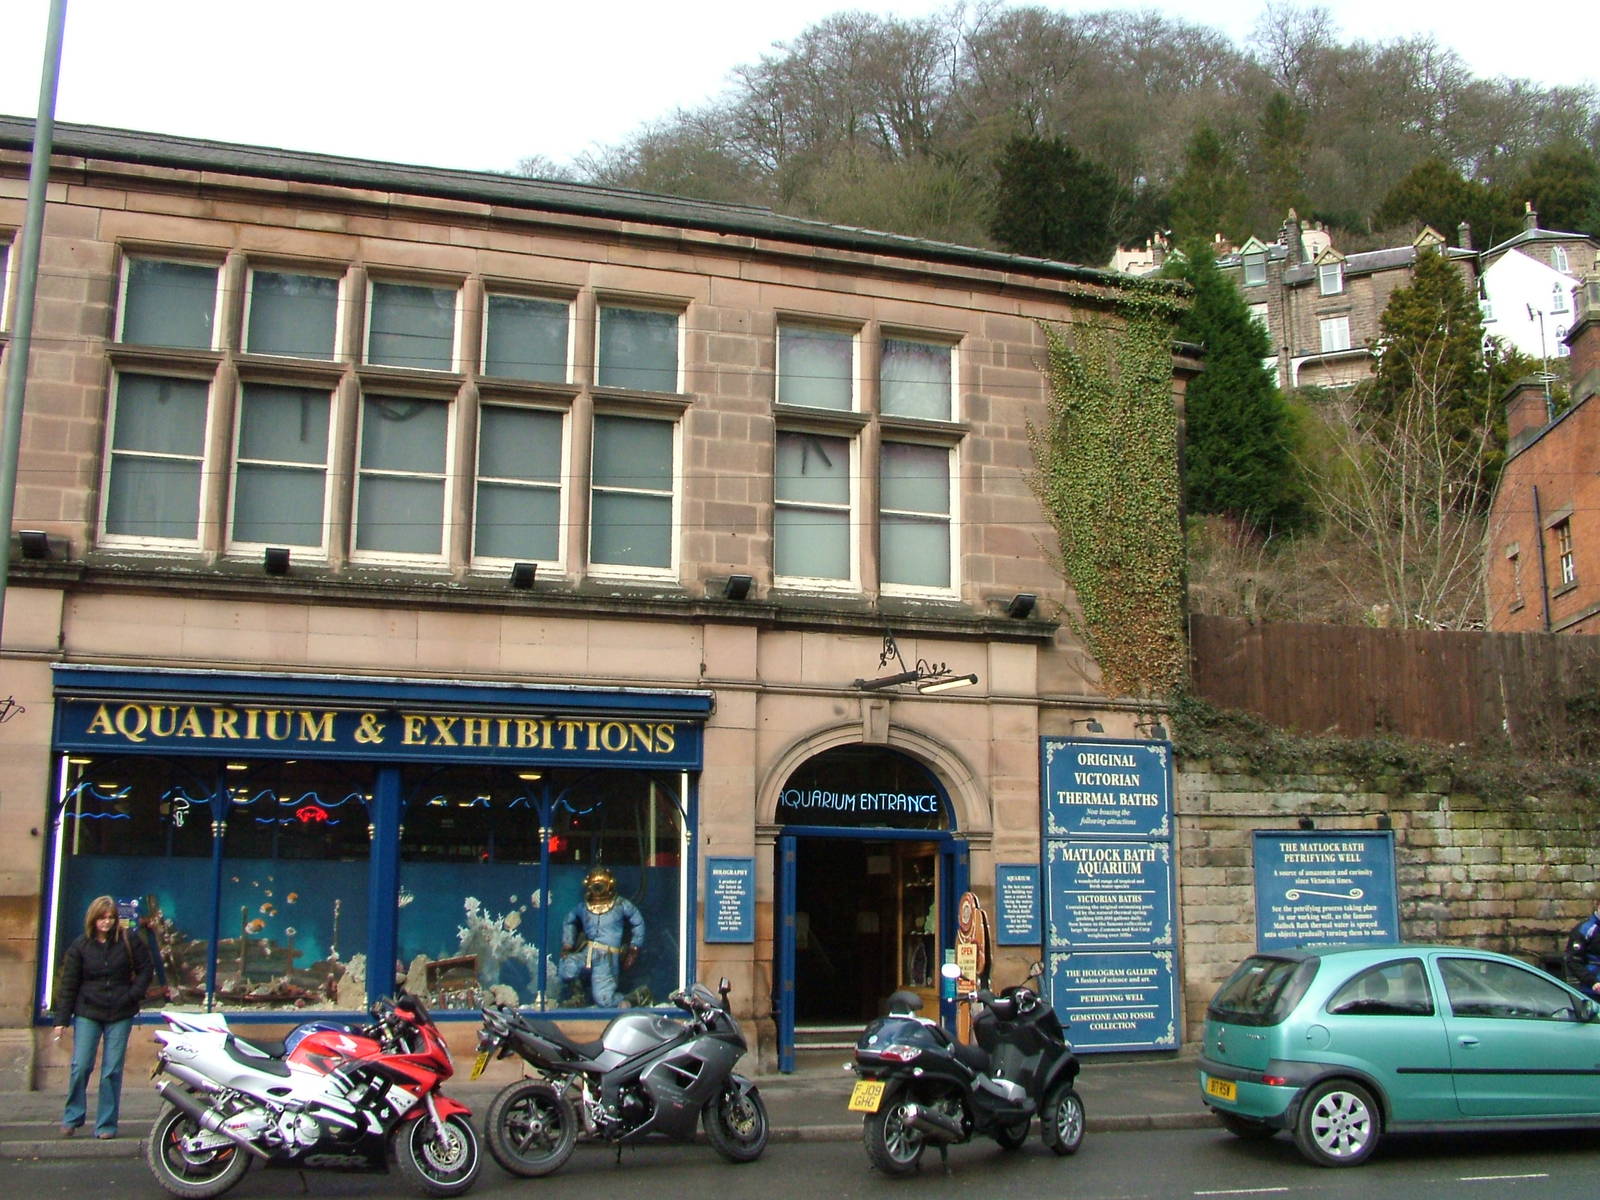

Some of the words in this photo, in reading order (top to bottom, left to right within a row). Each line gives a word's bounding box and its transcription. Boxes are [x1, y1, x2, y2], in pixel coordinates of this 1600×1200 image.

[86, 703, 338, 743] AQUARIUM
[354, 712, 386, 745] &
[401, 714, 676, 754] EXHIBITIONS
[1078, 753, 1136, 767] ORIGINAL
[1074, 772, 1140, 786] VICTORIAN
[779, 789, 856, 812] AQUARIUM
[860, 793, 938, 812] ENTRANCE
[1057, 791, 1116, 806] THERMAL
[1119, 793, 1158, 806] BATHS
[1280, 843, 1297, 852] THE
[1300, 843, 1340, 851] MATLOCK
[1342, 843, 1364, 851] BATH
[1062, 849, 1120, 861] MATLOCK
[1124, 849, 1155, 862] BATH
[1284, 854, 1336, 862] PETRIFYING
[1338, 854, 1361, 862] WELL
[1076, 862, 1142, 877] AQUARIUM
[1077, 895, 1117, 903] VICTORIAN
[1119, 895, 1142, 903] BATHS
[961, 947, 973, 955] OPEN
[1083, 969, 1124, 977] HOLOGRAM
[1126, 968, 1158, 976] GALLERY
[1080, 994, 1123, 1002] PETRIFYING
[1070, 1013, 1110, 1021] GEMSTONE
[1089, 1022, 1136, 1030] COLLECTION
[855, 1084, 882, 1097] FJ09
